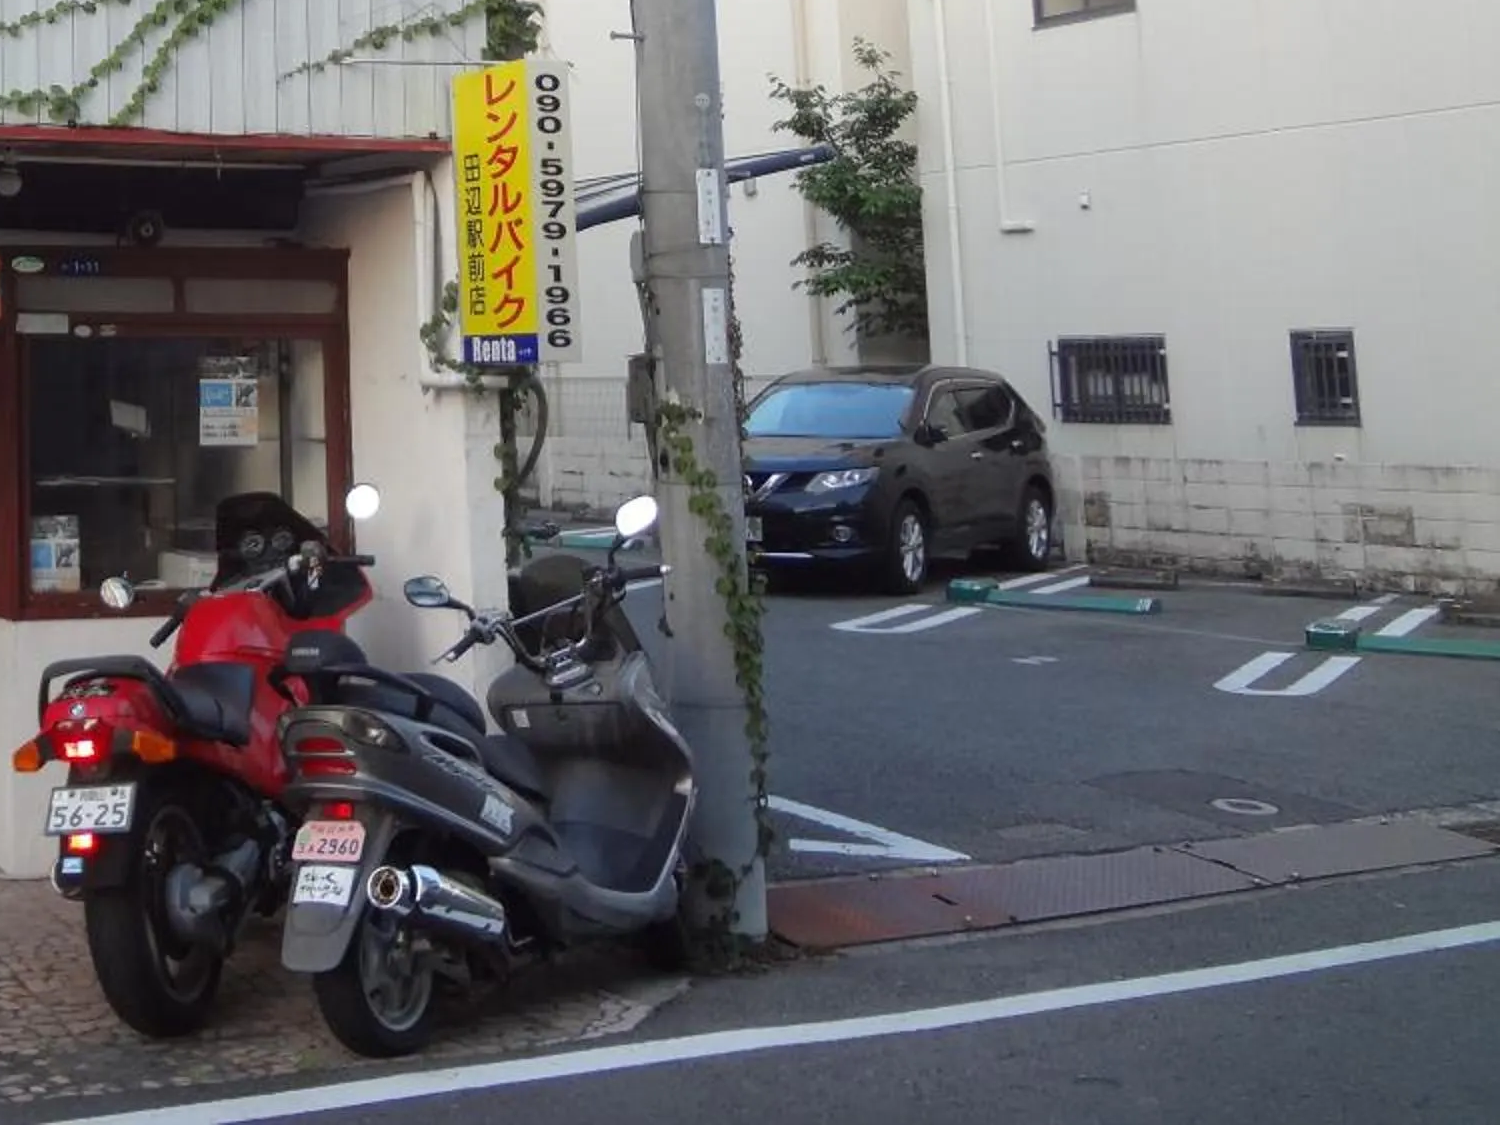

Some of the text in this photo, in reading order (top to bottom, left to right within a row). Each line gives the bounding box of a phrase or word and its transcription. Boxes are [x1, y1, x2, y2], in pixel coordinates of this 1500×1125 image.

[484, 73, 525, 330] レンタルバイク
[53, 802, 127, 828] 56-25
